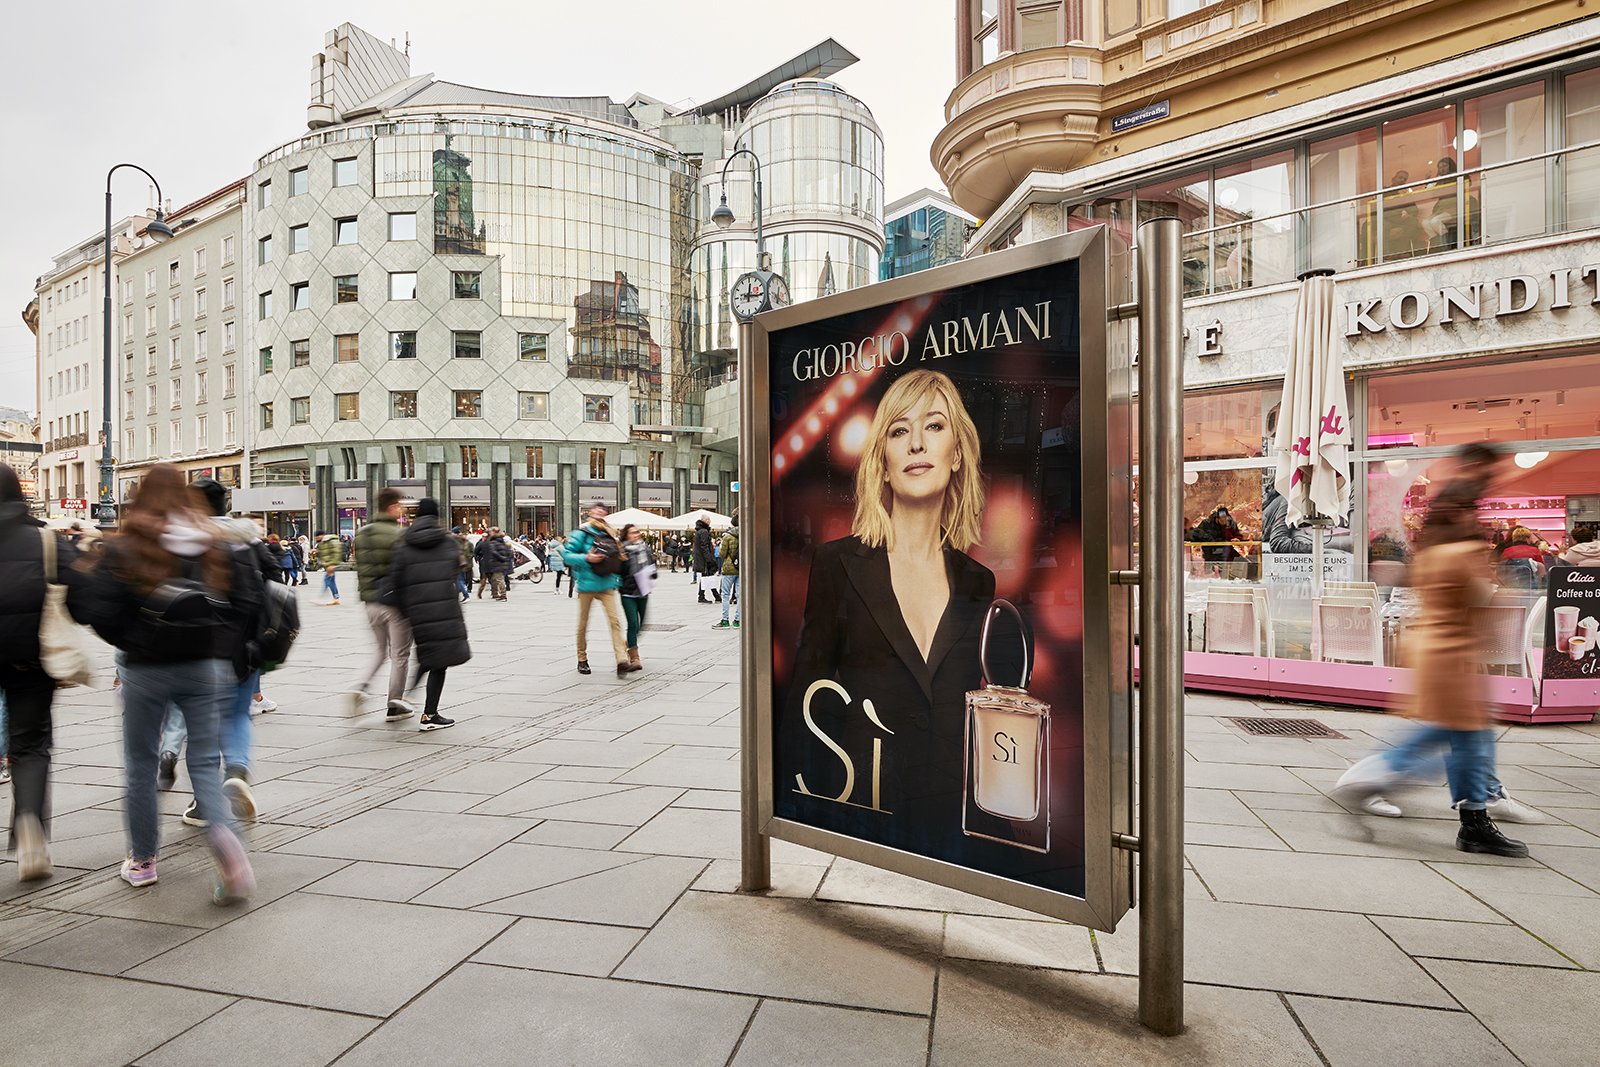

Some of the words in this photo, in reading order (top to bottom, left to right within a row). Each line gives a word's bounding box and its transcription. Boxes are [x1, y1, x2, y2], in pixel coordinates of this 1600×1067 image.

[792, 331, 910, 382] GIORGIO
[920, 301, 1053, 361] ARMANI
[1289, 565, 1299, 573] IM
[1556, 588, 1584, 598] Coffee
[1585, 589, 1594, 598] to
